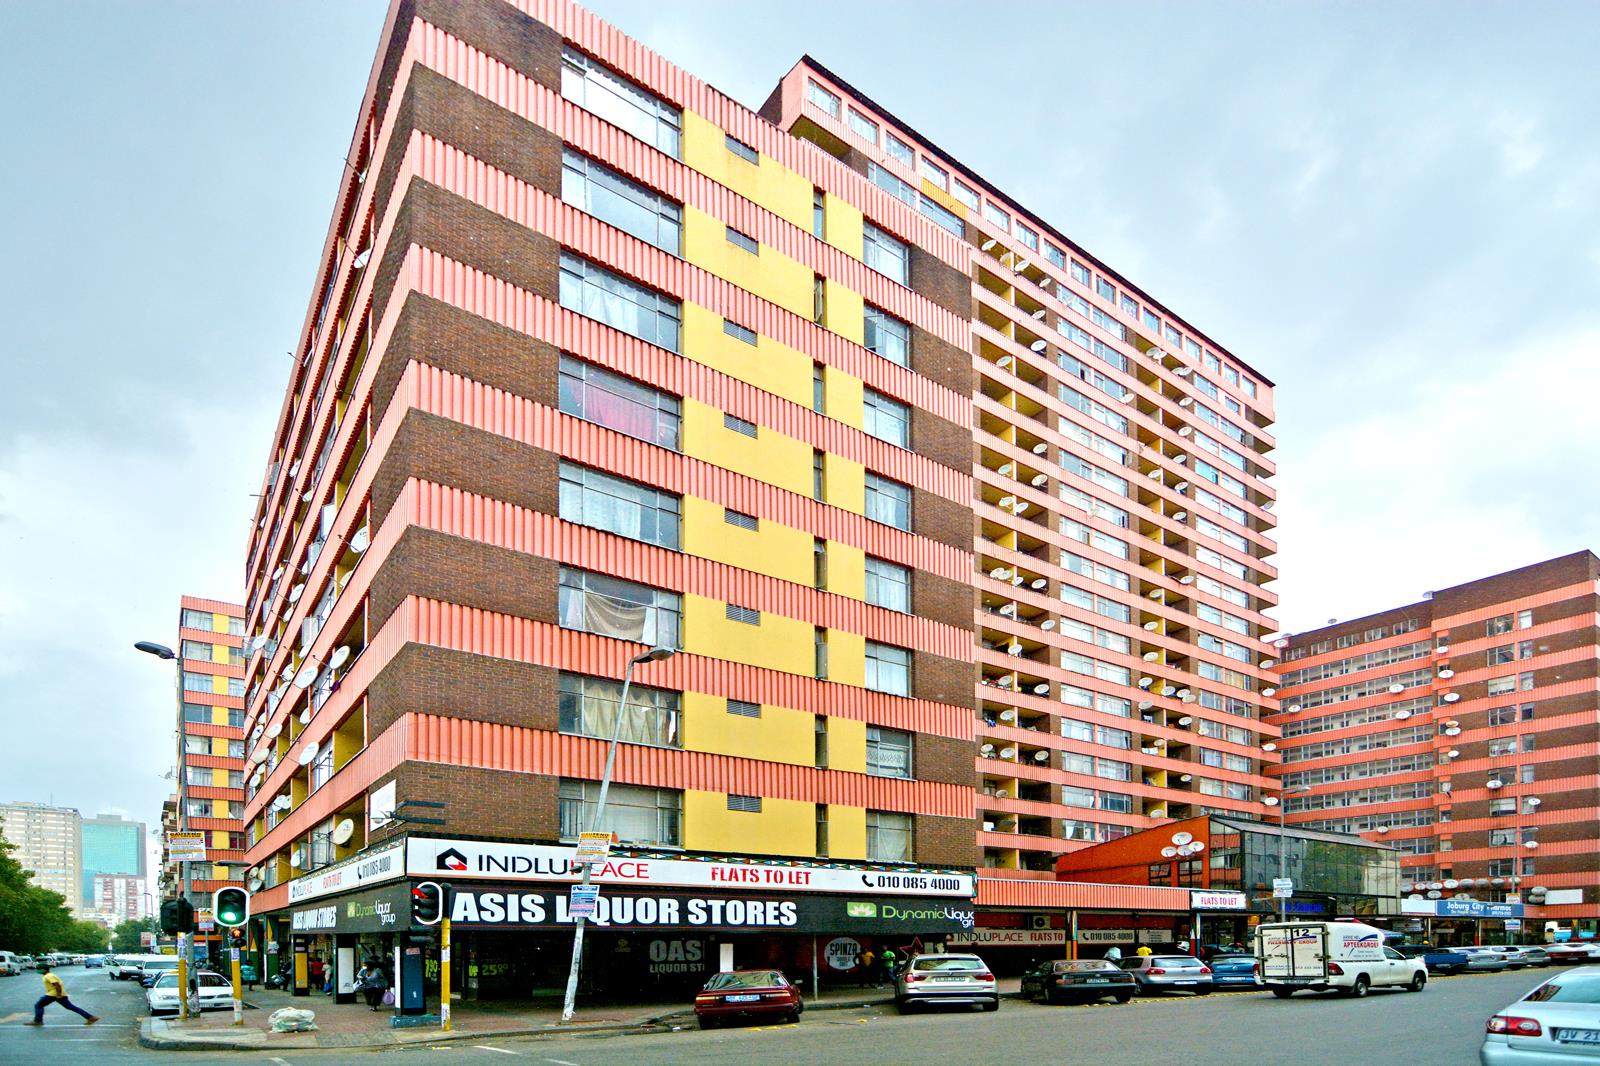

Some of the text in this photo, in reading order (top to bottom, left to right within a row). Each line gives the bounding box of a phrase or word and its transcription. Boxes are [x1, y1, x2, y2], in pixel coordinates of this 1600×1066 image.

[711, 867, 812, 885] FLATS TO LET
[878, 875, 960, 890] 010 085 4000
[1200, 896, 1237, 906] FLATS TO LET
[451, 892, 546, 923] ASIS
[556, 895, 680, 926] LQUOR
[687, 898, 798, 926] STORES
[1446, 901, 1470, 911] Joburg
[1471, 902, 1485, 912] City
[381, 912, 396, 926] group
[957, 932, 1063, 942] INDLUPLACE FLATS TO
[1090, 932, 1133, 940] 010 085 4000
[1293, 928, 1310, 937] 12
[649, 940, 705, 962] OAS
[649, 964, 688, 974] LIQUOR
[1561, 1030, 1577, 1039] JV
